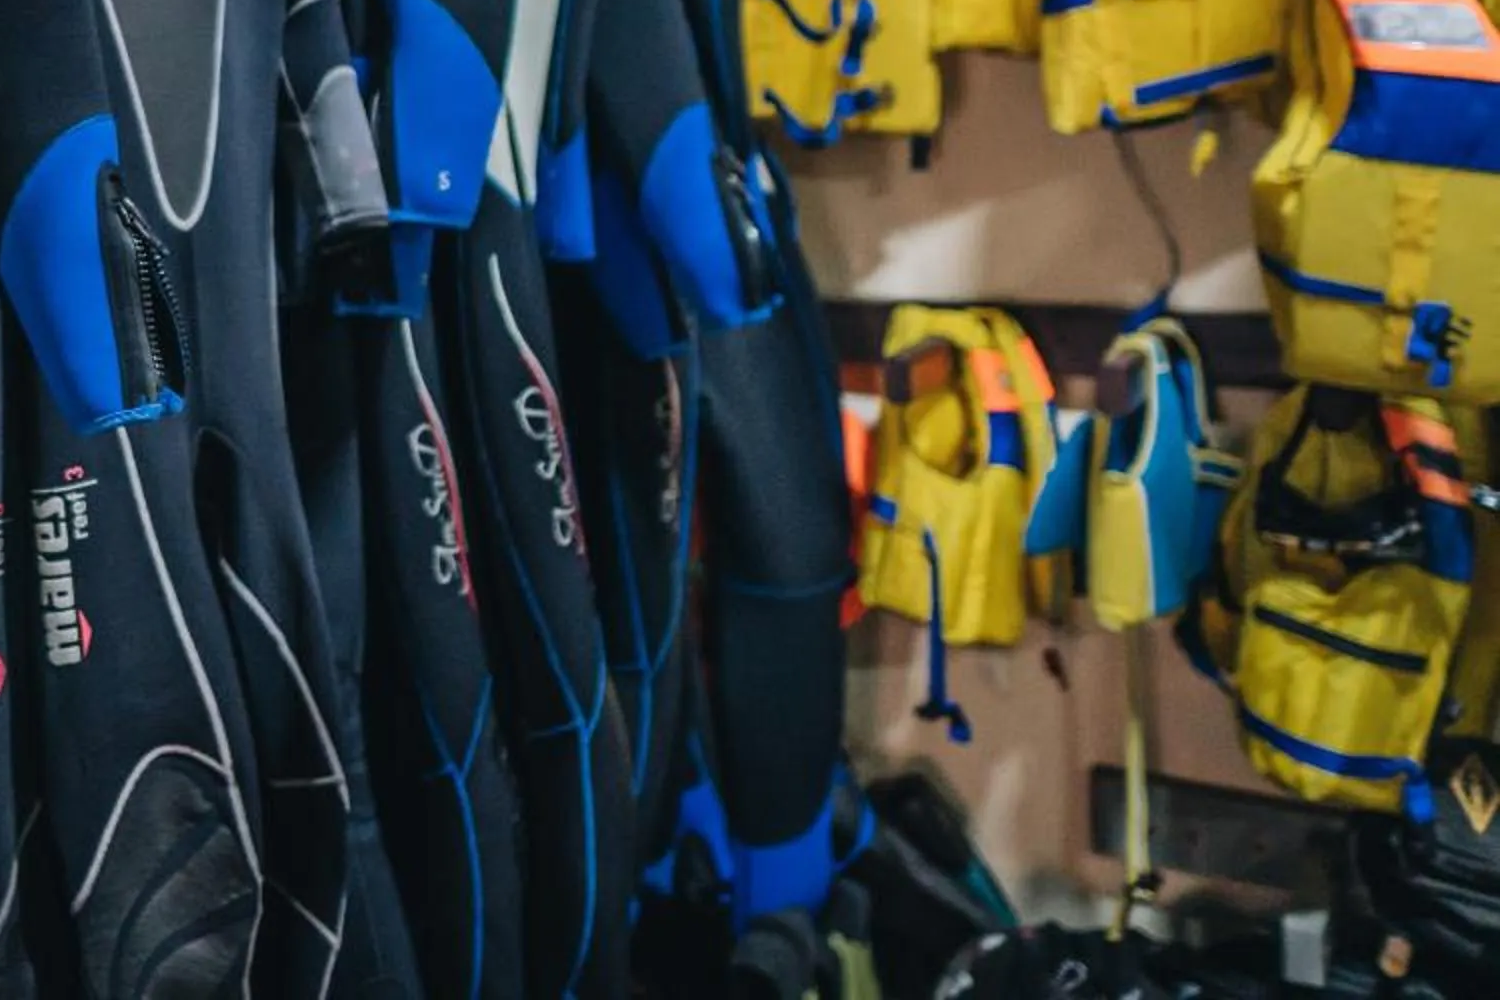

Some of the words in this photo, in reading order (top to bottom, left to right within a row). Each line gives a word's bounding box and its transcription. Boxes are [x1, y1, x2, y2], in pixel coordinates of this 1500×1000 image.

[63, 464, 85, 482] 3
[66, 491, 90, 541] reef
[33, 495, 82, 667] mares
